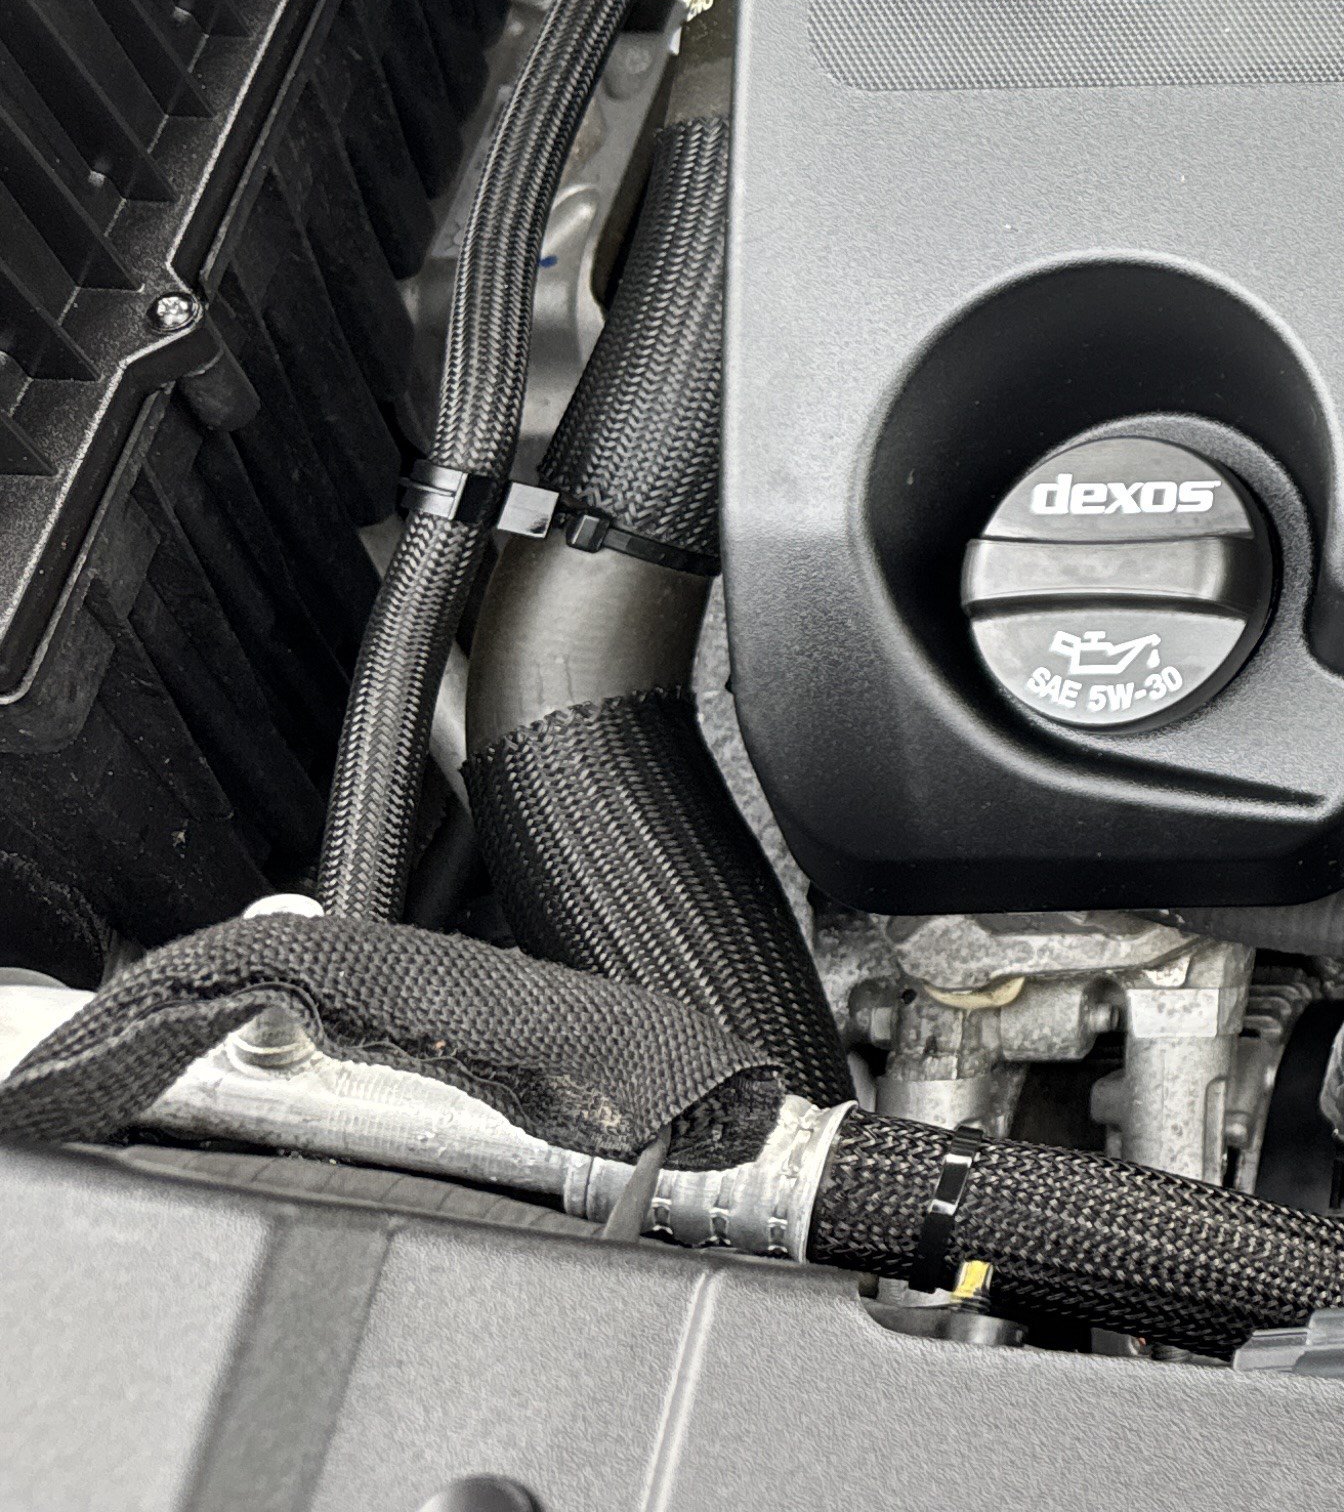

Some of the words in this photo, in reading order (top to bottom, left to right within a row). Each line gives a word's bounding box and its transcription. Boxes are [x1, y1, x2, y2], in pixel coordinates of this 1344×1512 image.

[1029, 472, 1222, 515] dexos
[1026, 666, 1083, 709] SAE
[1086, 665, 1185, 713] 5W-30
